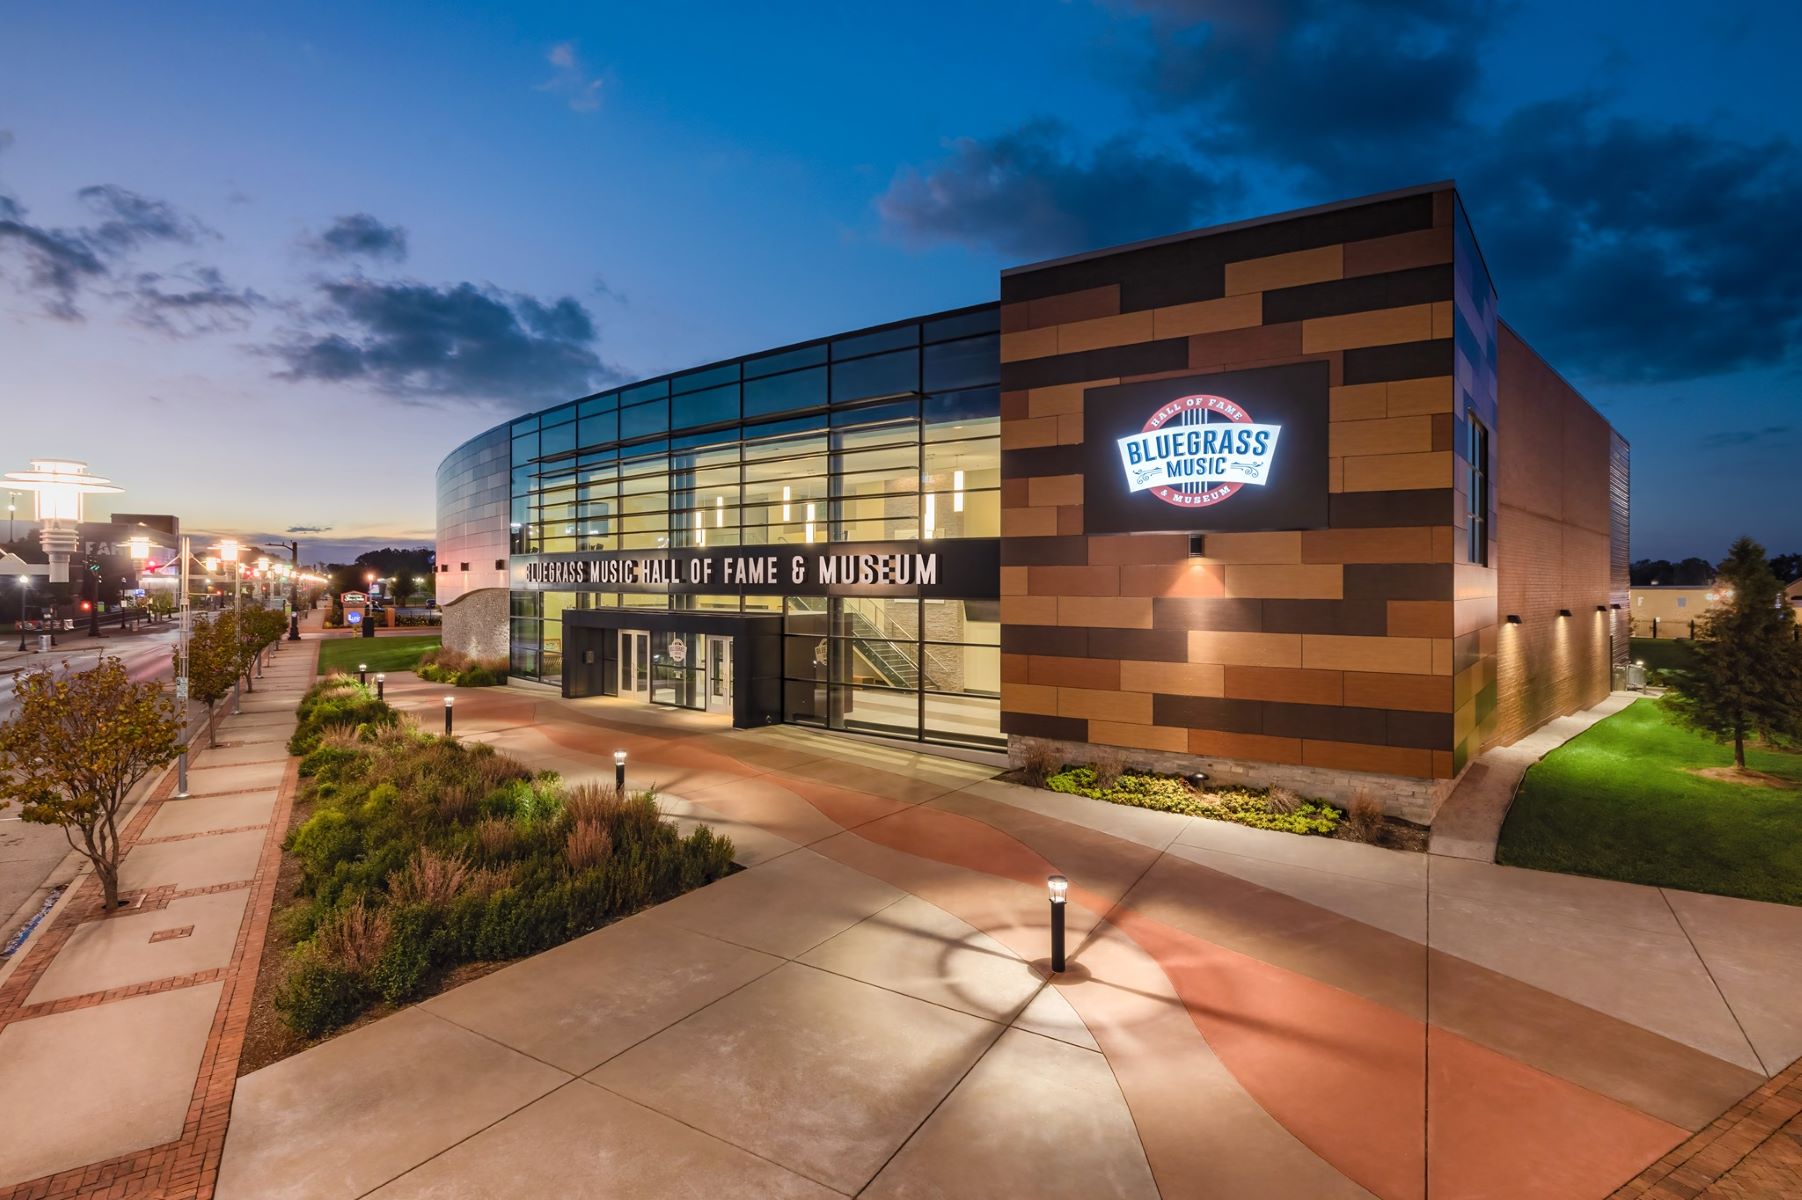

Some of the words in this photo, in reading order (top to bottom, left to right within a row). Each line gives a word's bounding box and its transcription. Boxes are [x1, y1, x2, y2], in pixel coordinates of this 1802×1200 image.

[1151, 403, 1181, 427] HALL
[1186, 398, 1203, 406] OF
[1208, 398, 1243, 420] FAME
[1127, 429, 1270, 465] BLUEGRASS
[1166, 456, 1227, 478] MUSIC
[1160, 489, 1168, 497] &
[1172, 486, 1231, 504] MUSEUM
[526, 560, 584, 584] BLUEGRASS
[590, 559, 633, 583] MUSIC
[642, 559, 680, 584] HALL
[690, 558, 712, 584] OF
[724, 557, 777, 584] FAME
[791, 556, 805, 584] &
[819, 553, 937, 585] MUSEUM
